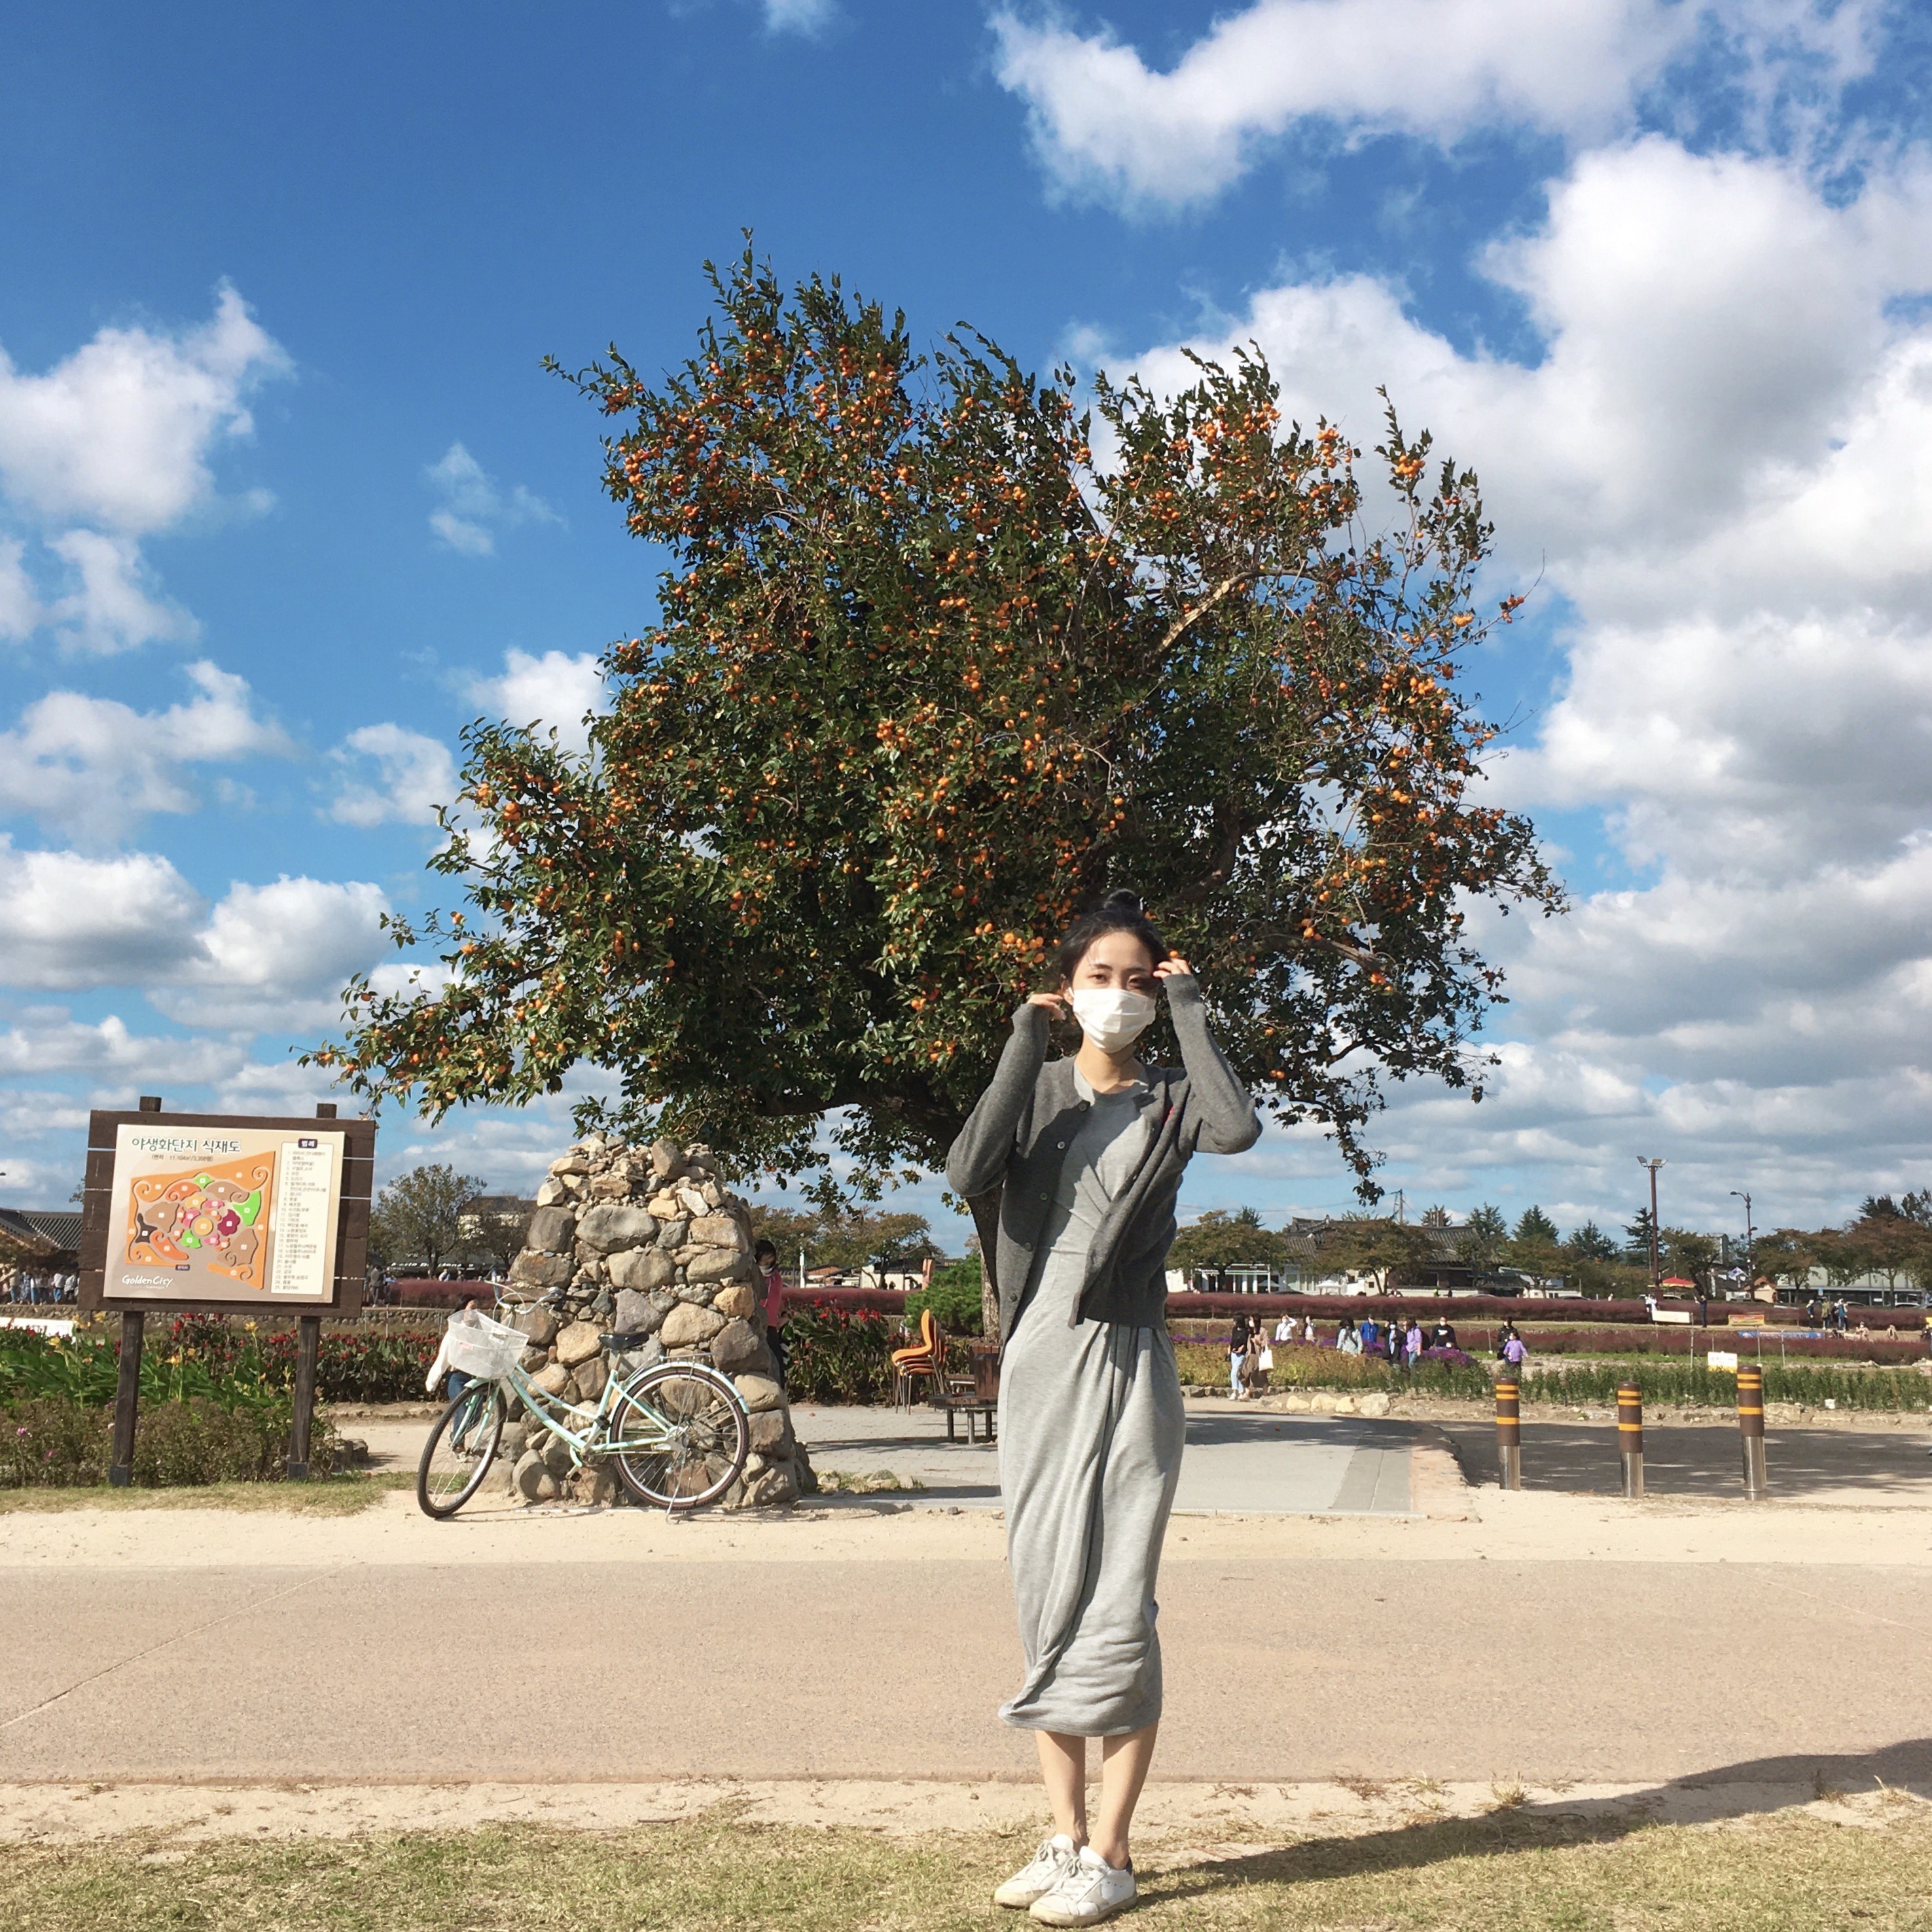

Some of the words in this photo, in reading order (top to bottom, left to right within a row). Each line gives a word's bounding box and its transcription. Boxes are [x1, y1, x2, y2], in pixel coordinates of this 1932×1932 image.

[132, 1137, 197, 1153] 야생화단지
[202, 1139, 240, 1153] 식재도
[122, 1274, 152, 1285] Golden
[152, 1276, 173, 1288] City
